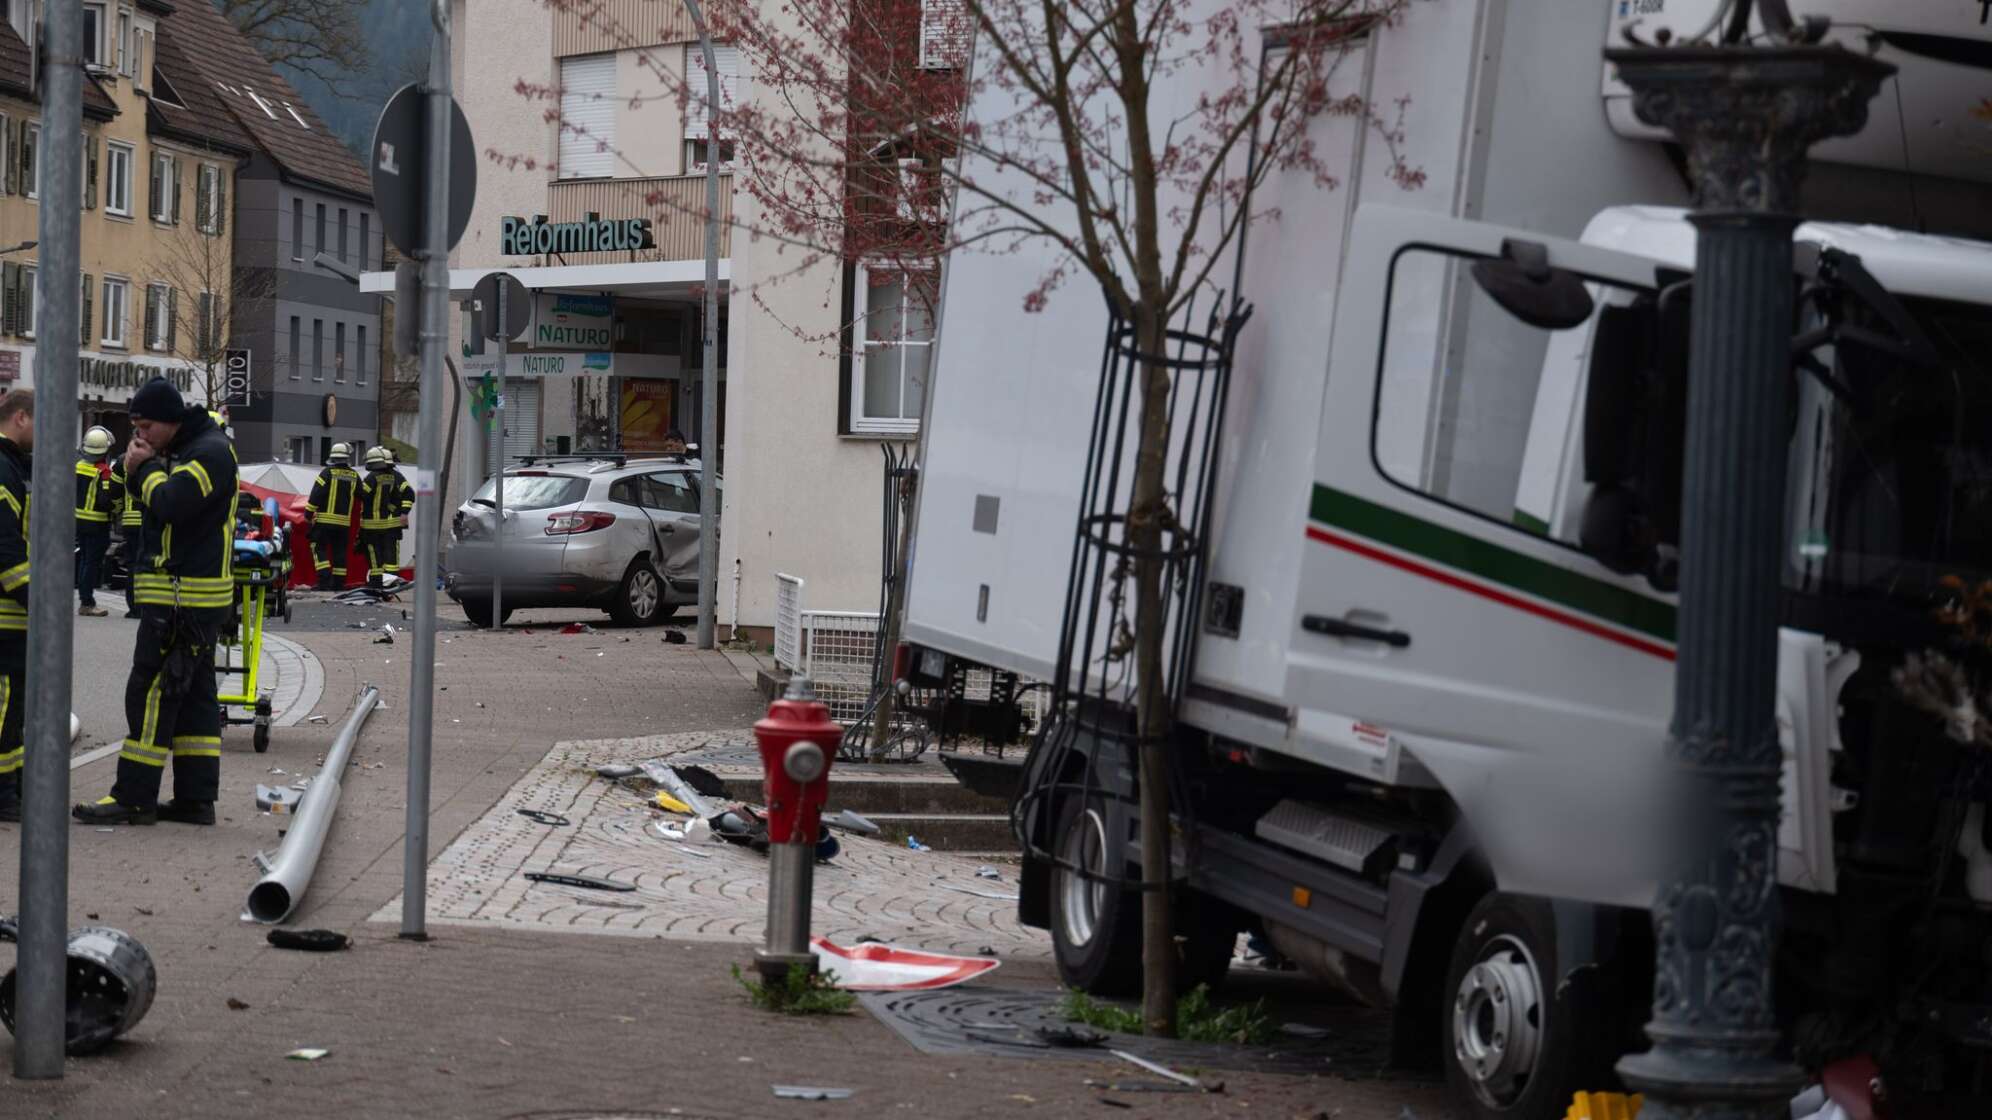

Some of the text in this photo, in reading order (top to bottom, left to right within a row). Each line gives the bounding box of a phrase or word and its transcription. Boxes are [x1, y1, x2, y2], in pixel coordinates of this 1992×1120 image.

[501, 212, 648, 255] Reformhaus
[539, 324, 610, 345] NATURO
[523, 355, 564, 374] NATURO
